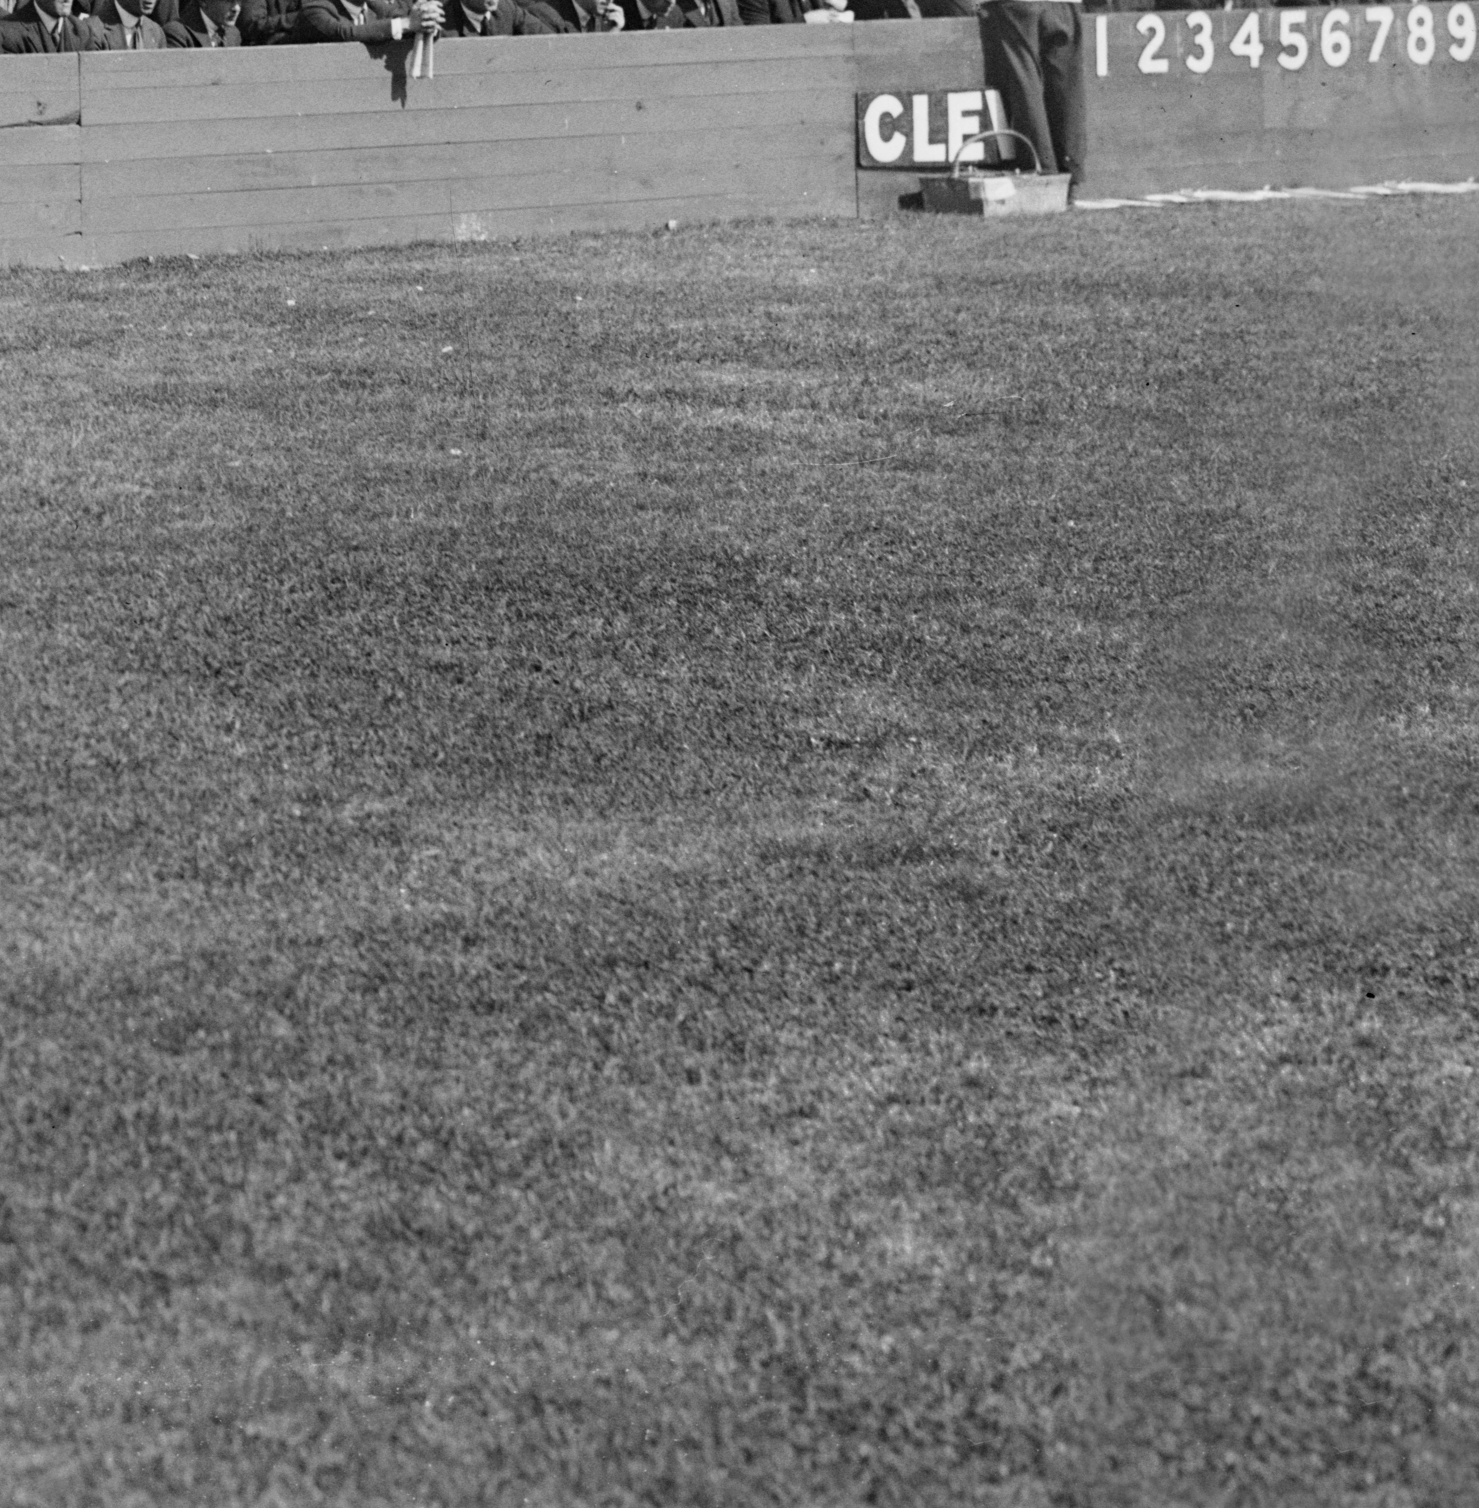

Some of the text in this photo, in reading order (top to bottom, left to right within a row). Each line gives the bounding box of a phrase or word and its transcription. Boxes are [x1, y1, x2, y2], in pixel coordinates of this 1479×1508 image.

[1095, 2, 1477, 76] 1 2 3 4 5 6 7 8 9
